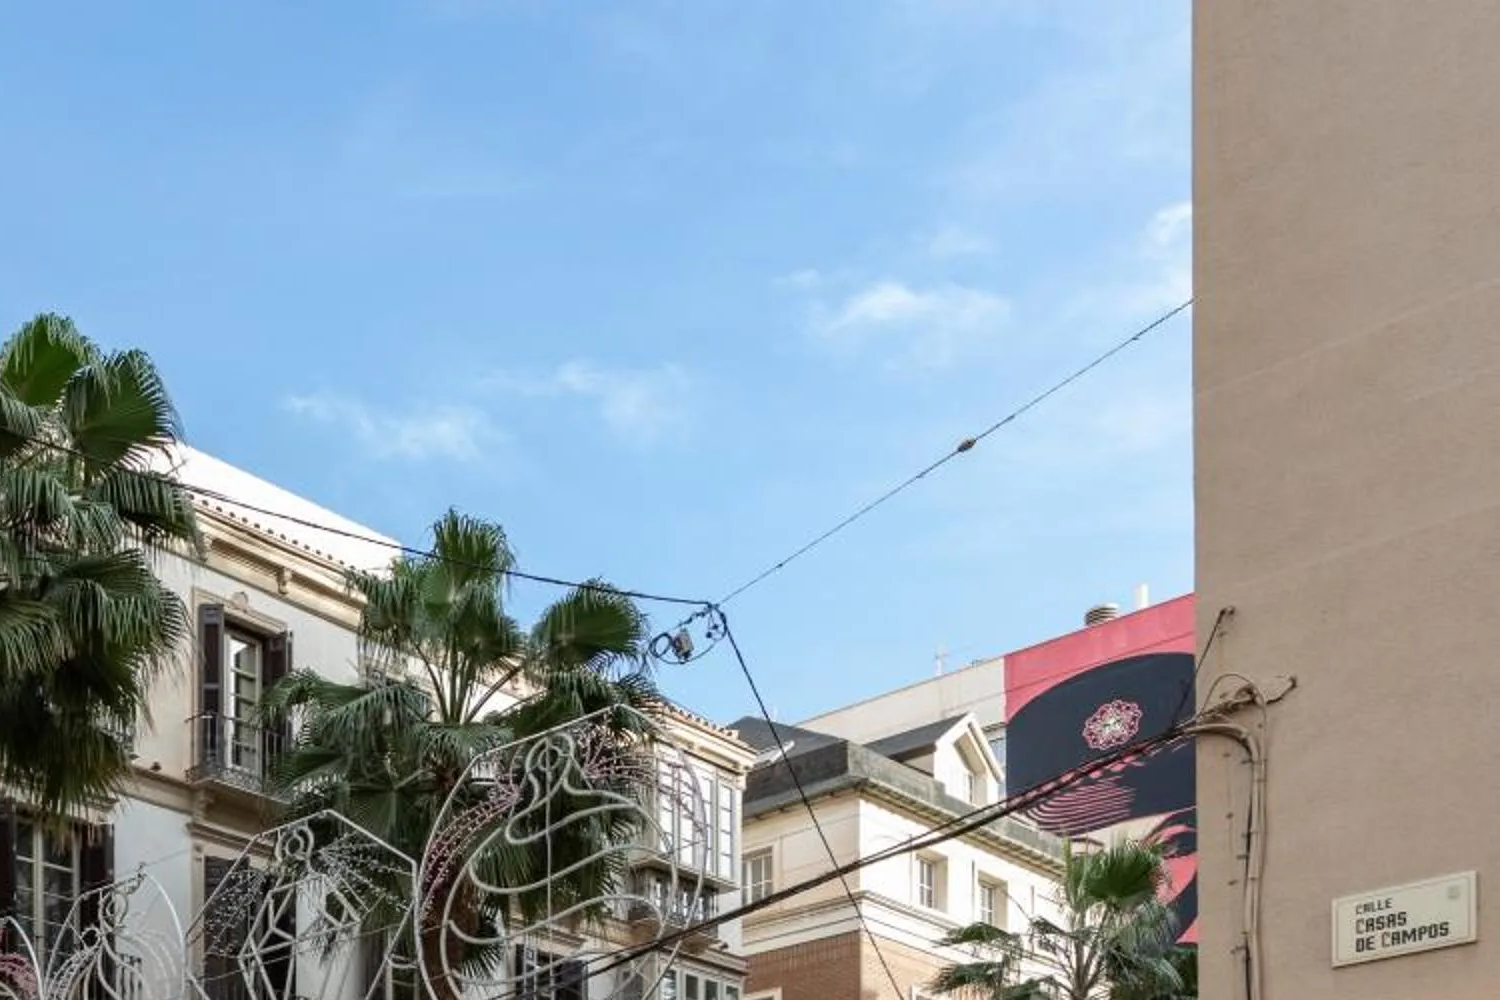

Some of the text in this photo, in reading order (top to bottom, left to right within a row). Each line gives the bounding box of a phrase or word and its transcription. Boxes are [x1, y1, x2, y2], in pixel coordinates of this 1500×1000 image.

[1356, 898, 1393, 915] CALLE
[1355, 911, 1407, 934] CASAS
[1355, 921, 1449, 953] DE CAMPOS
